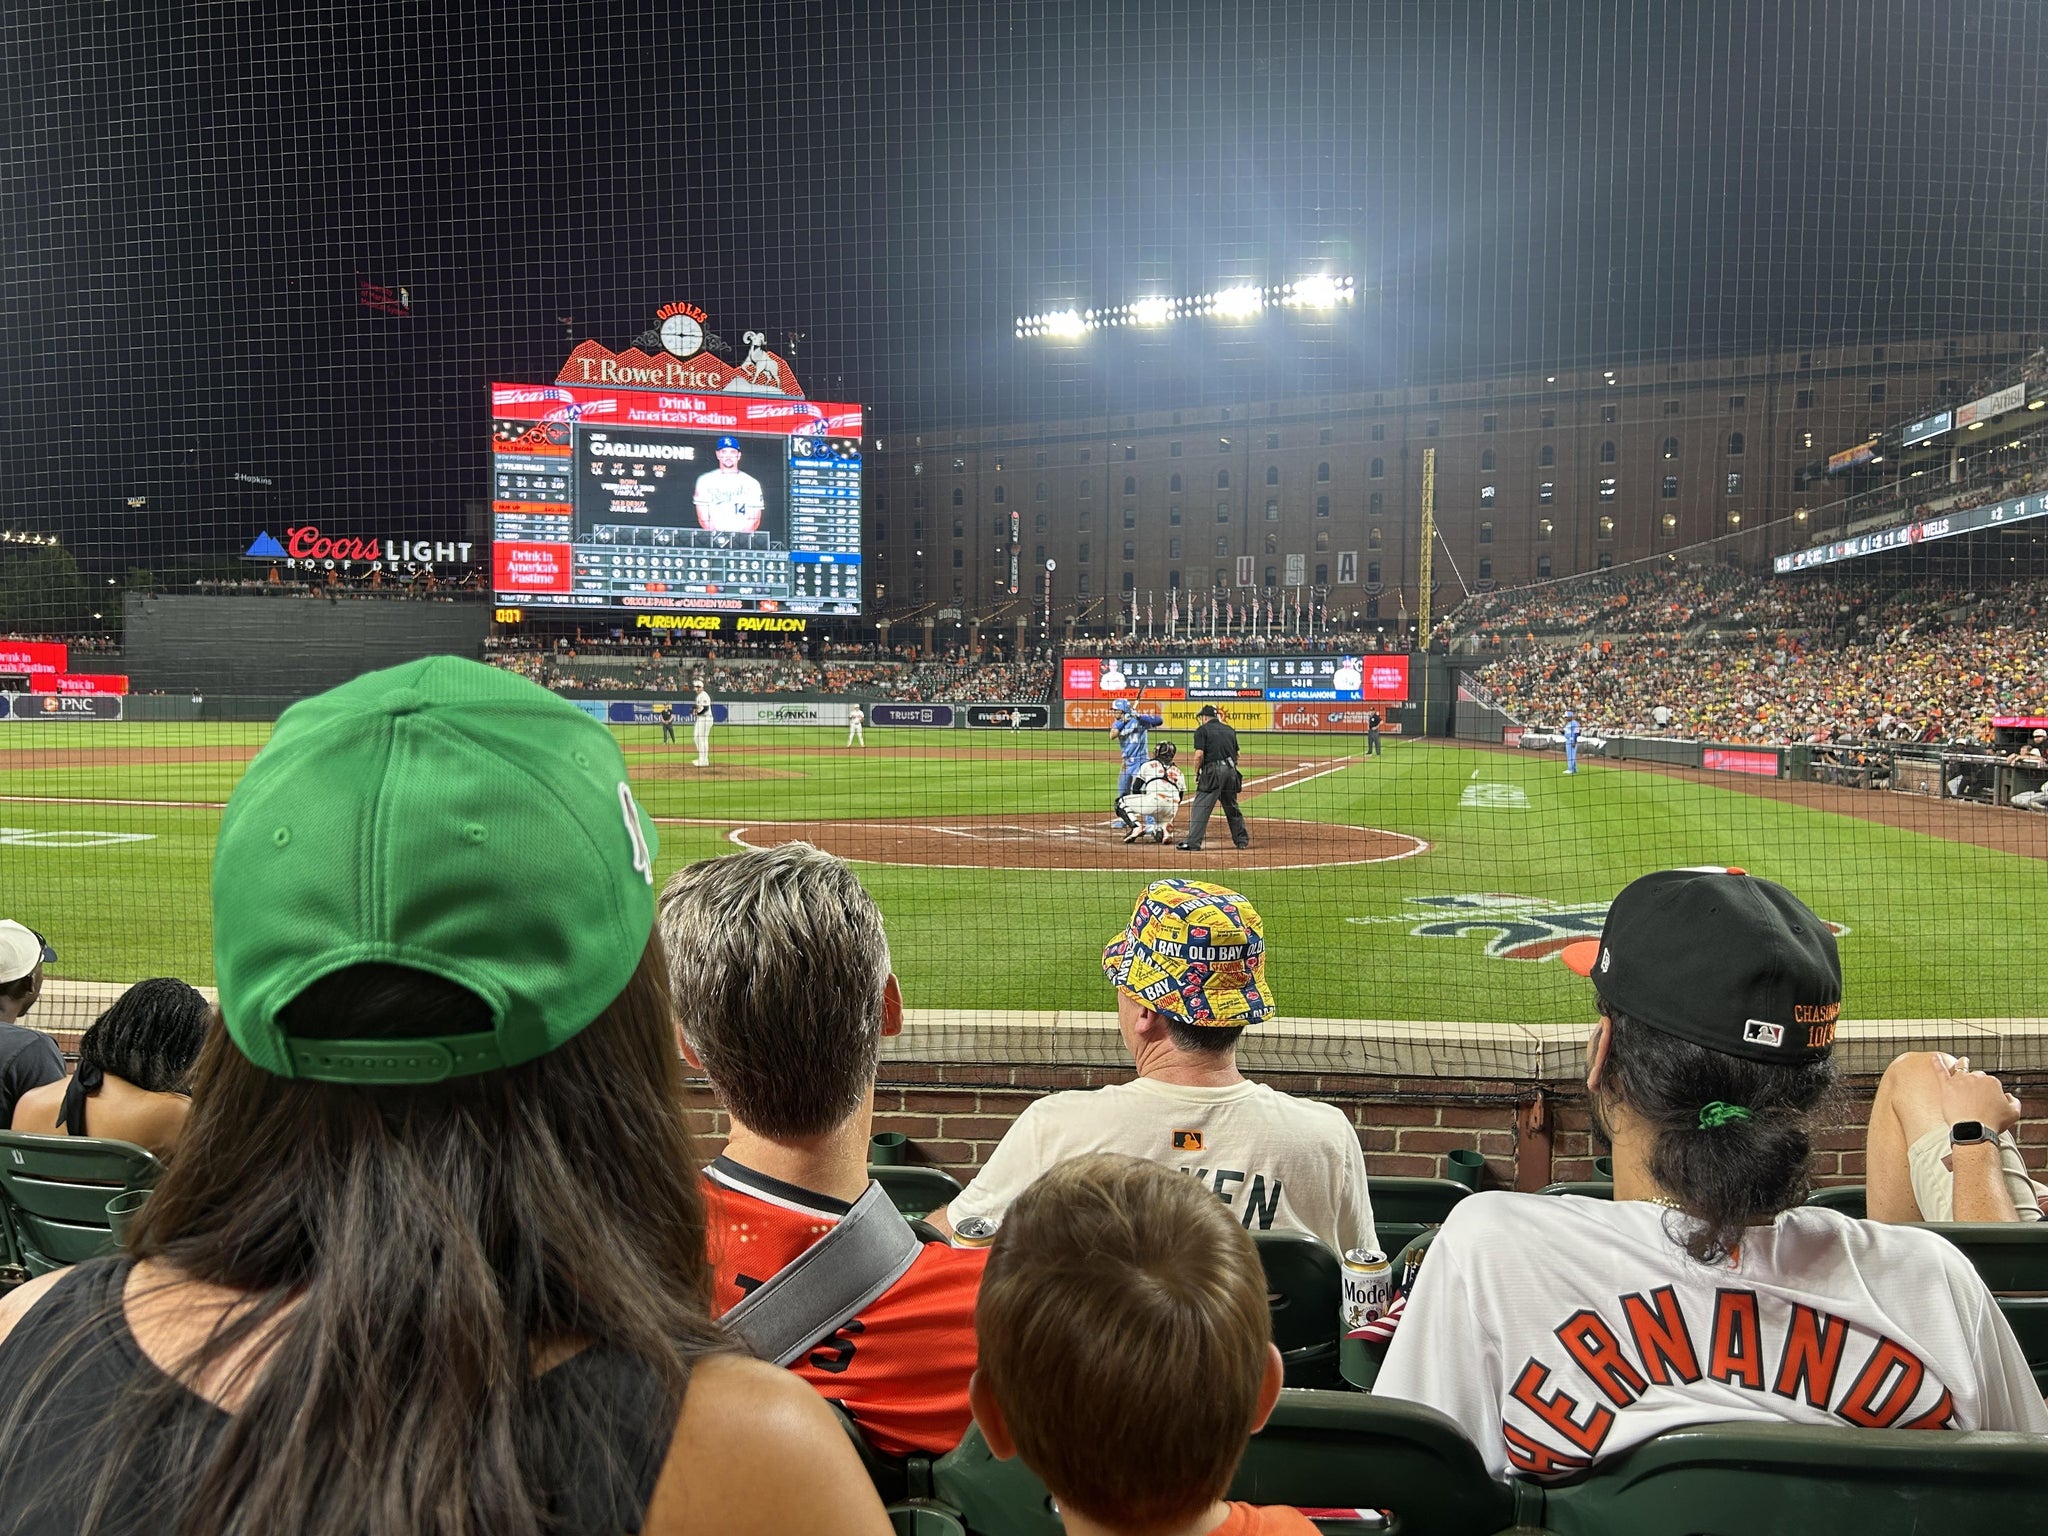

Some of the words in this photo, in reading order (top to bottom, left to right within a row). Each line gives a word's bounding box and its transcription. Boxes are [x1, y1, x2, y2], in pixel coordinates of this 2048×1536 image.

[657, 301, 708, 324] ORIOLES
[601, 359, 664, 386] Rowe
[666, 366, 722, 389] Price
[659, 396, 692, 412] Drink
[694, 398, 707, 412] in
[628, 407, 688, 423] America's
[688, 410, 738, 426] Pastime
[234, 472, 240, 480] 2
[241, 473, 272, 485] Hopkins
[734, 503, 746, 515] 14
[1922, 519, 1949, 537] WELLS
[287, 526, 382, 560] Coors
[386, 540, 472, 562] LIGHT
[512, 550, 542, 561] Drink
[287, 558, 351, 570] ROOF
[373, 560, 434, 573] DECK
[507, 561, 559, 573] America's
[612, 556, 620, 565] 0
[624, 556, 633, 565] 0
[637, 556, 646, 566] 0
[650, 557, 660, 566] 0
[663, 558, 672, 567] 0
[675, 558, 683, 568] 0
[690, 559, 696, 568] 1
[701, 559, 709, 568] 0
[729, 560, 735, 569] 1
[740, 561, 748, 570] 2
[752, 561, 760, 570] 0
[767, 561, 774, 570] 4
[779, 562, 785, 571] 1
[512, 573, 554, 584] Pastime
[612, 569, 620, 578] 0
[637, 570, 646, 579] 0
[651, 570, 659, 580] 2
[689, 572, 697, 580] 0
[728, 573, 736, 582] 6
[740, 573, 748, 582] 6
[767, 574, 774, 583] 2
[622, 597, 653, 606] ORIOLE
[654, 598, 674, 607] PARK
[684, 599, 717, 609] CAMDEN
[717, 600, 743, 609] YARDS
[636, 615, 721, 631] PUREWAGER
[736, 617, 807, 632] PAVILION
[0, 653, 20, 662] rink
[61, 699, 94, 711] PNC
[776, 711, 817, 719] RANKIN
[889, 710, 920, 720] TRUIST
[1282, 712, 1319, 727] HIGH'S
[1189, 946, 1216, 961] OLD
[1218, 945, 1243, 961] BAY
